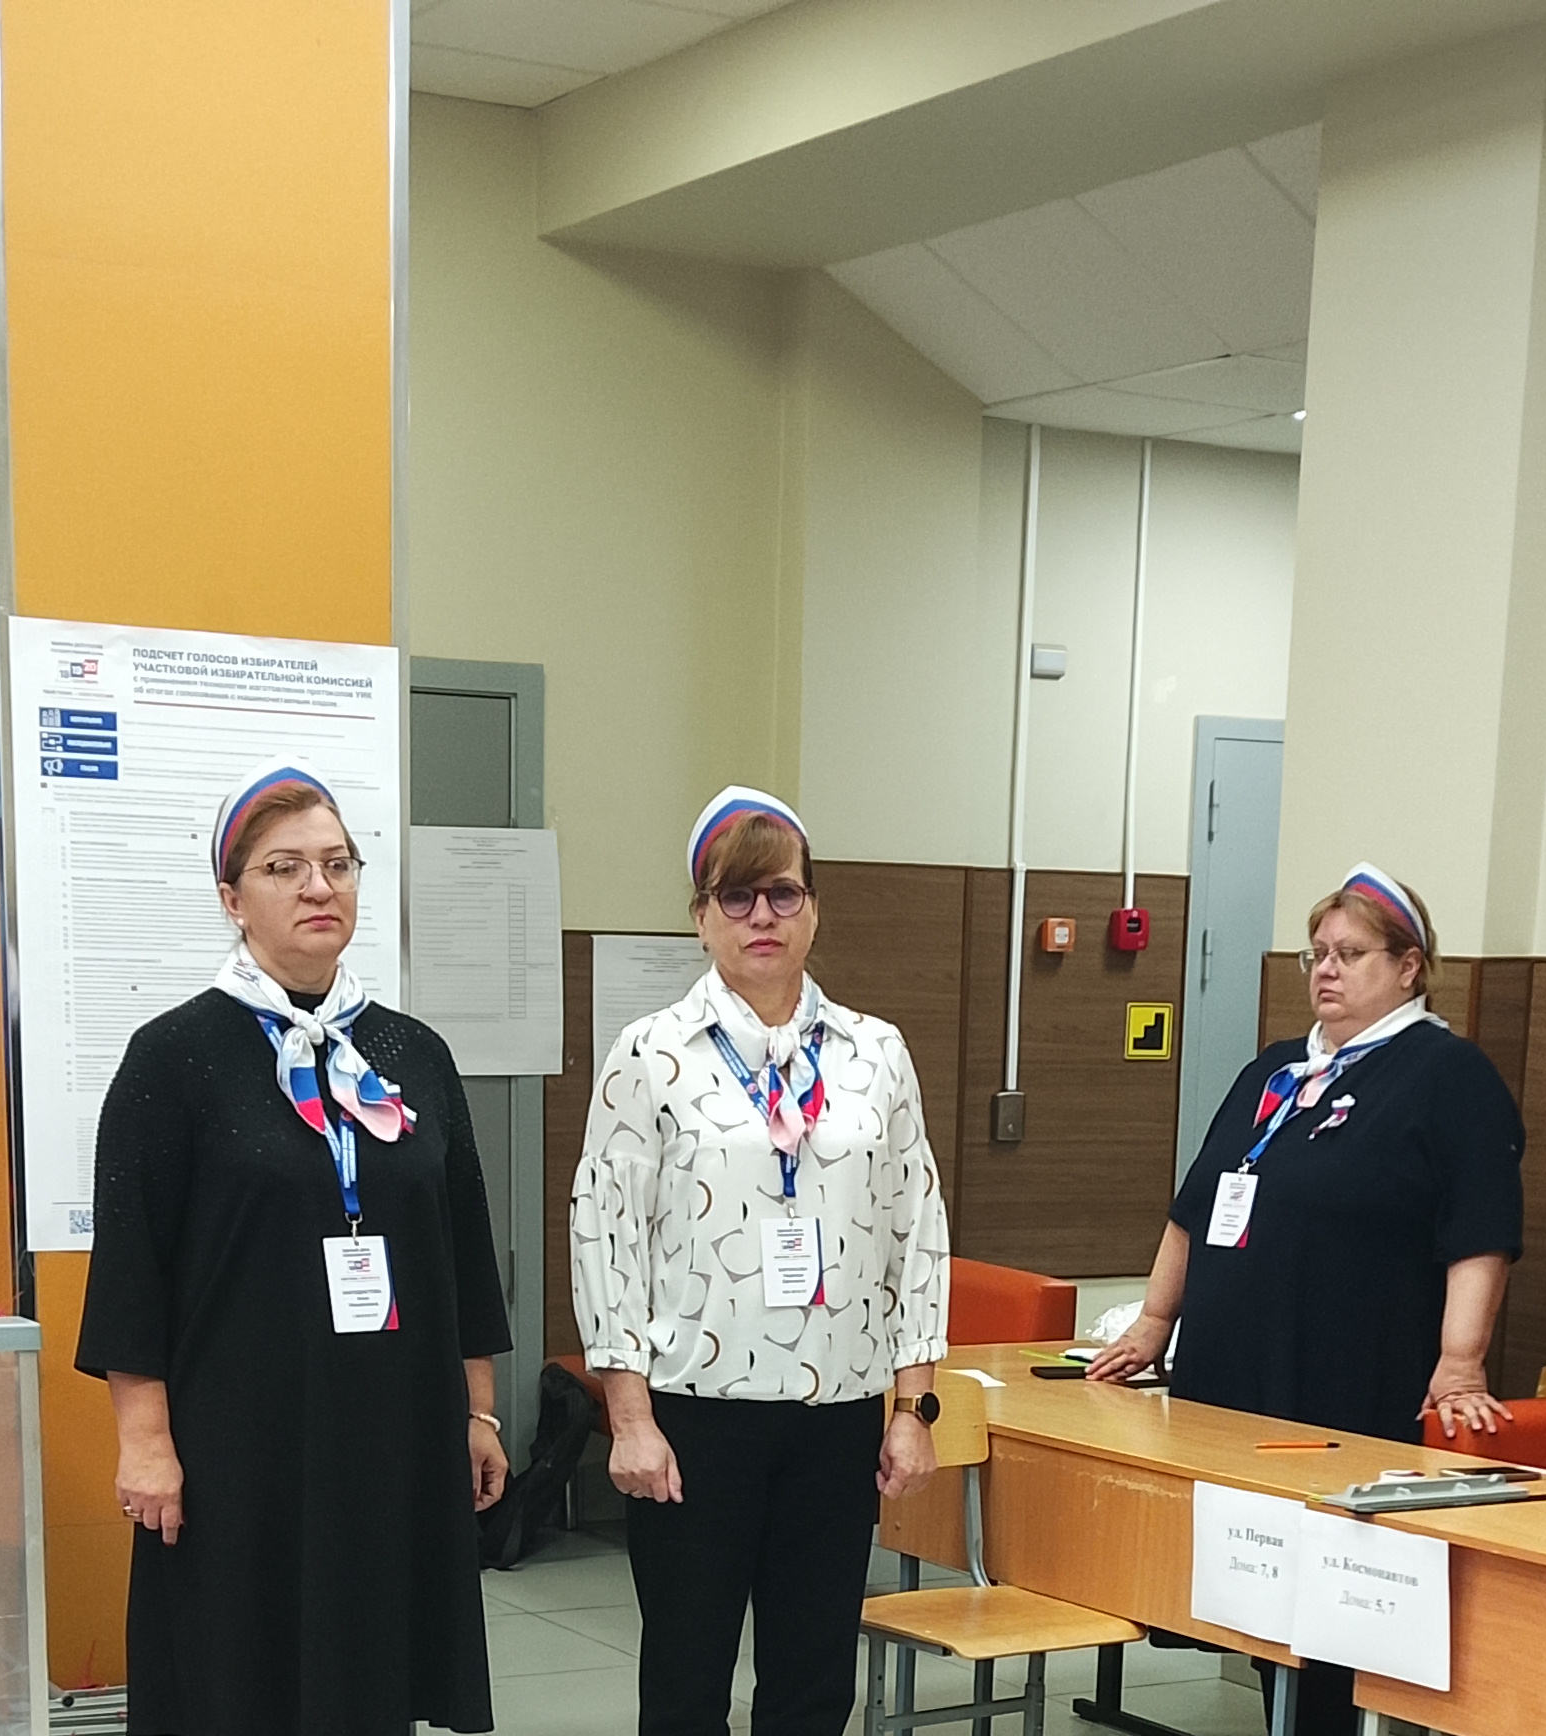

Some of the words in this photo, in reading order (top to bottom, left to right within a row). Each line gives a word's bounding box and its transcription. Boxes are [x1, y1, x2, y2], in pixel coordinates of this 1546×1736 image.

[132, 648, 184, 661] ПОДСЧЕТ
[187, 651, 238, 665] ГОЛОСОВ
[241, 655, 318, 671] ИЗБИРАТЕЛЕЙ
[133, 661, 208, 676] УЧАСТКОВОЙ
[211, 667, 304, 683] ИЗБИРАТЕЛЬНОЙ
[307, 673, 373, 688] КОМИССИЕЙ
[1227, 1525, 1243, 1540] ул.
[1245, 1527, 1284, 1549] Первая
[1271, 1566, 1279, 1579] 8
[1343, 1556, 1419, 1588] Космонавтов
